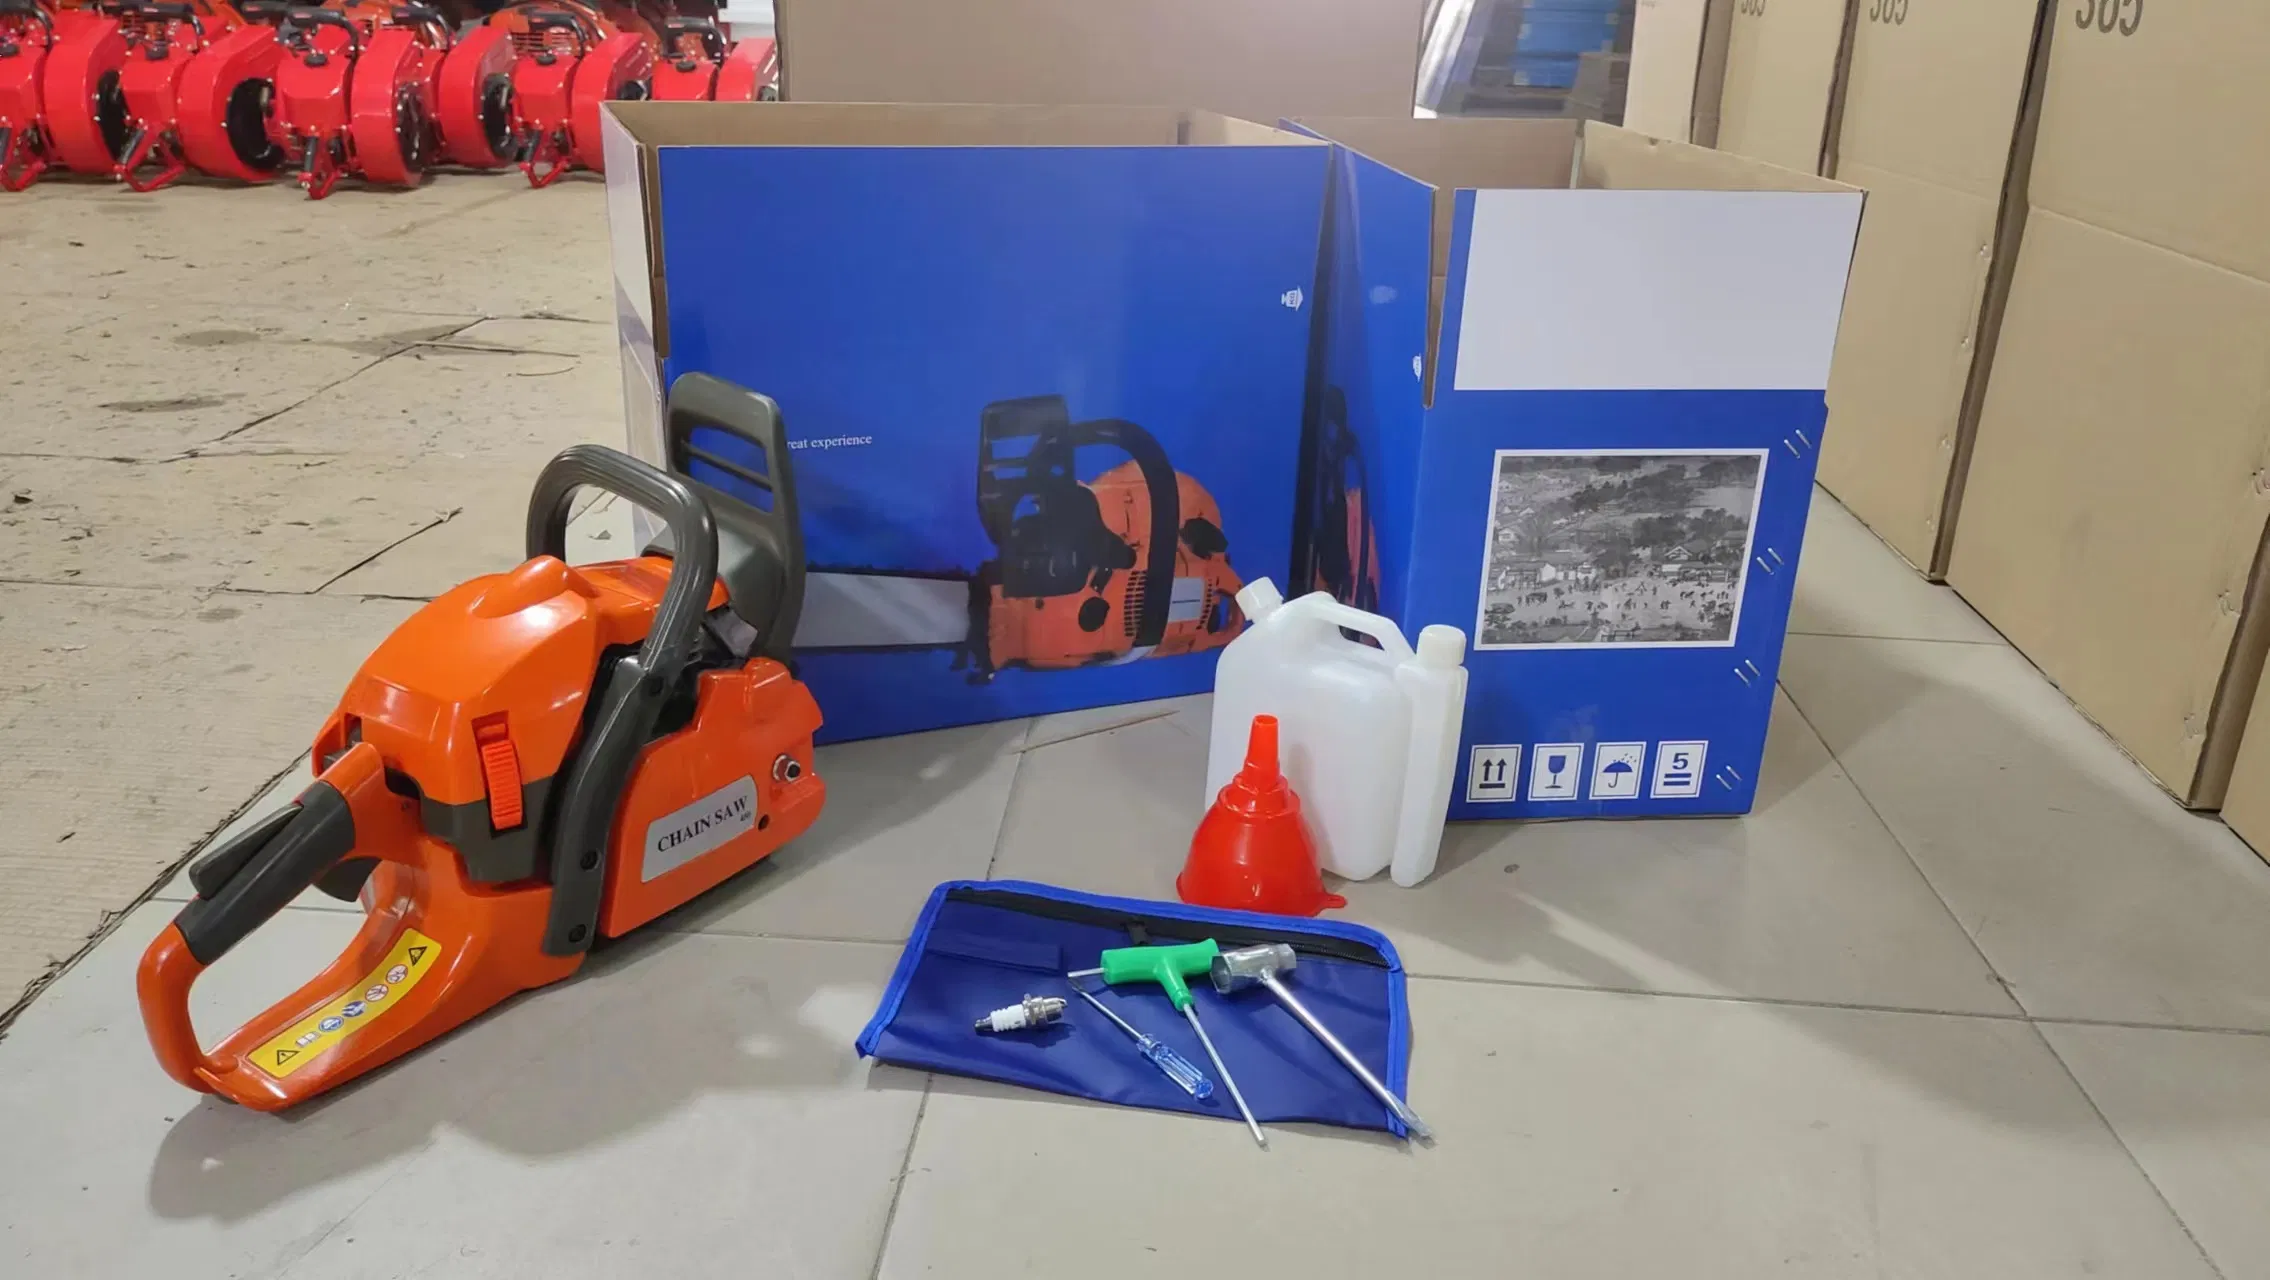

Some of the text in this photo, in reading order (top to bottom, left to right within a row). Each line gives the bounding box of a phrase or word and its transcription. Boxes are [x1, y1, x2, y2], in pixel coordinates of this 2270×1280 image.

[787, 434, 873, 450] reat experience
[1672, 752, 1689, 770] 5
[657, 795, 748, 852] CHAIN SAW
